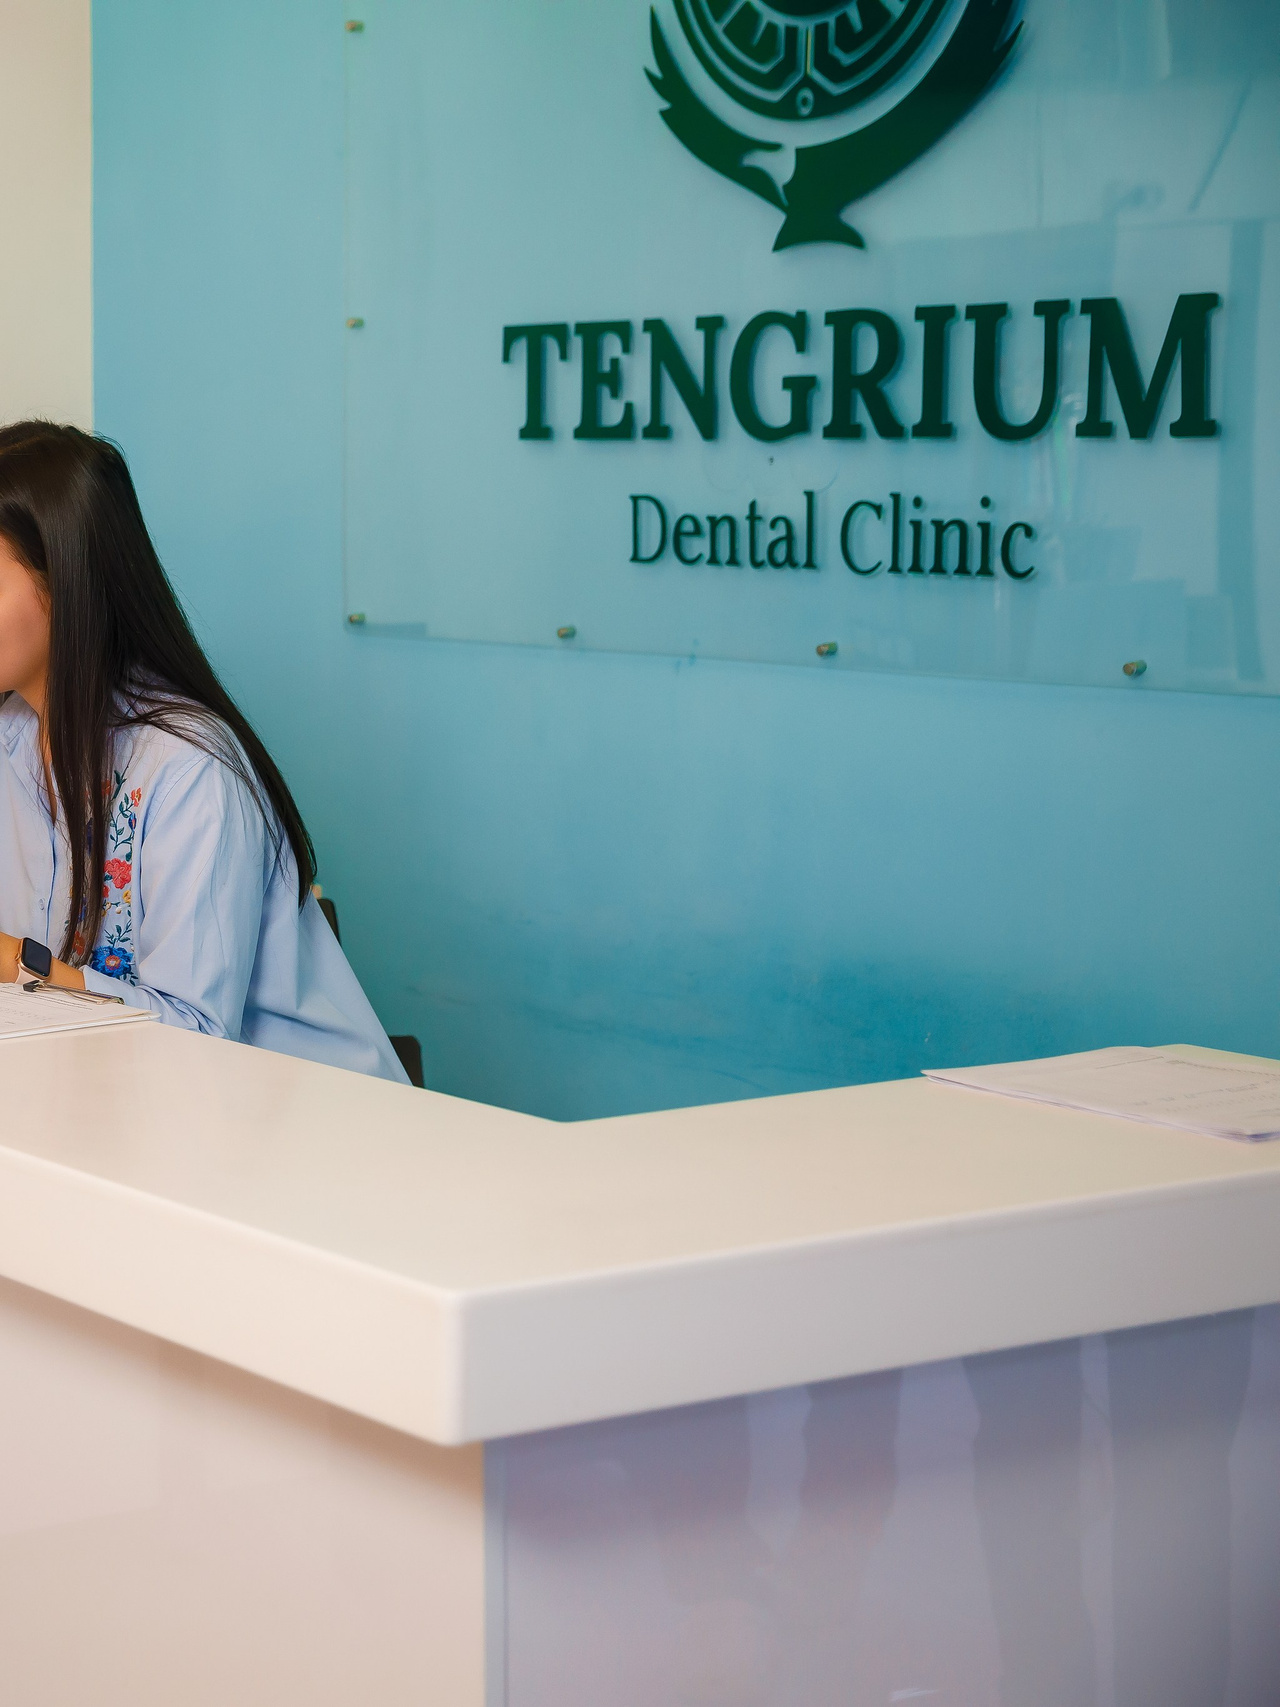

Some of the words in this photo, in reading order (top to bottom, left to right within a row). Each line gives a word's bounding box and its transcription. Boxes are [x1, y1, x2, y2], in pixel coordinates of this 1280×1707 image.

[503, 292, 1220, 442] TENGRIUM
[629, 490, 818, 570] Dental
[840, 491, 1035, 580] Clinic
